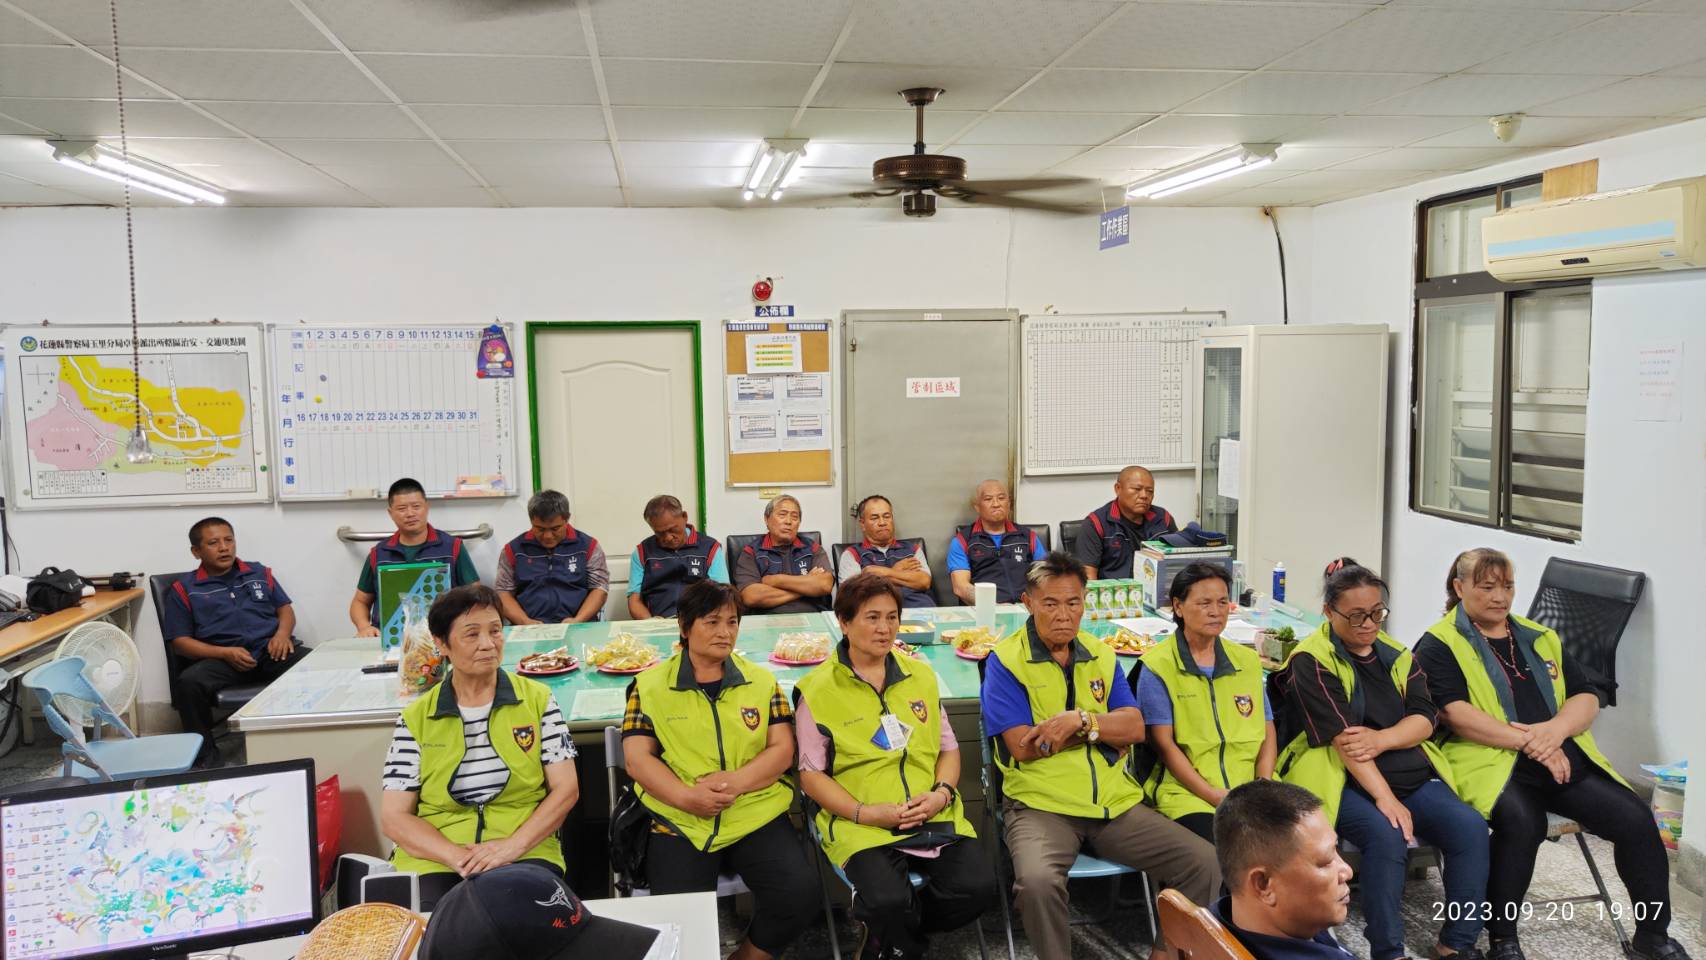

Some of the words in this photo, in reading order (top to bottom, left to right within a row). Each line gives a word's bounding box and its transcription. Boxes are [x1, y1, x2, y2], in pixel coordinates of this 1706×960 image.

[317, 330, 324, 340] 2
[329, 330, 336, 340] 3
[340, 330, 348, 340] 4
[352, 330, 360, 340] 5
[363, 330, 371, 340] 6
[376, 330, 382, 340] 7
[386, 330, 394, 340] 8
[398, 330, 405, 340] 9
[408, 330, 418, 340] 10
[420, 330, 429, 340] 11
[431, 330, 441, 340] 12
[442, 330, 453, 340] 13
[454, 330, 463, 340] 14
[465, 330, 475, 340] 15
[911, 381, 958, 394] 管制區域
[296, 411, 306, 421] 16
[308, 411, 317, 421] 17
[320, 411, 329, 421] 18
[331, 411, 341, 421] 19
[343, 411, 353, 421] 20
[355, 411, 364, 421] 21
[366, 411, 375, 421] 22
[377, 411, 387, 421] 23
[389, 411, 399, 421] 24
[400, 411, 410, 421] 25
[411, 411, 421, 421] 26
[423, 411, 432, 421] 27
[434, 411, 444, 421] 28
[446, 411, 455, 421] 29
[457, 411, 467, 421] 30
[469, 411, 477, 421] 31
